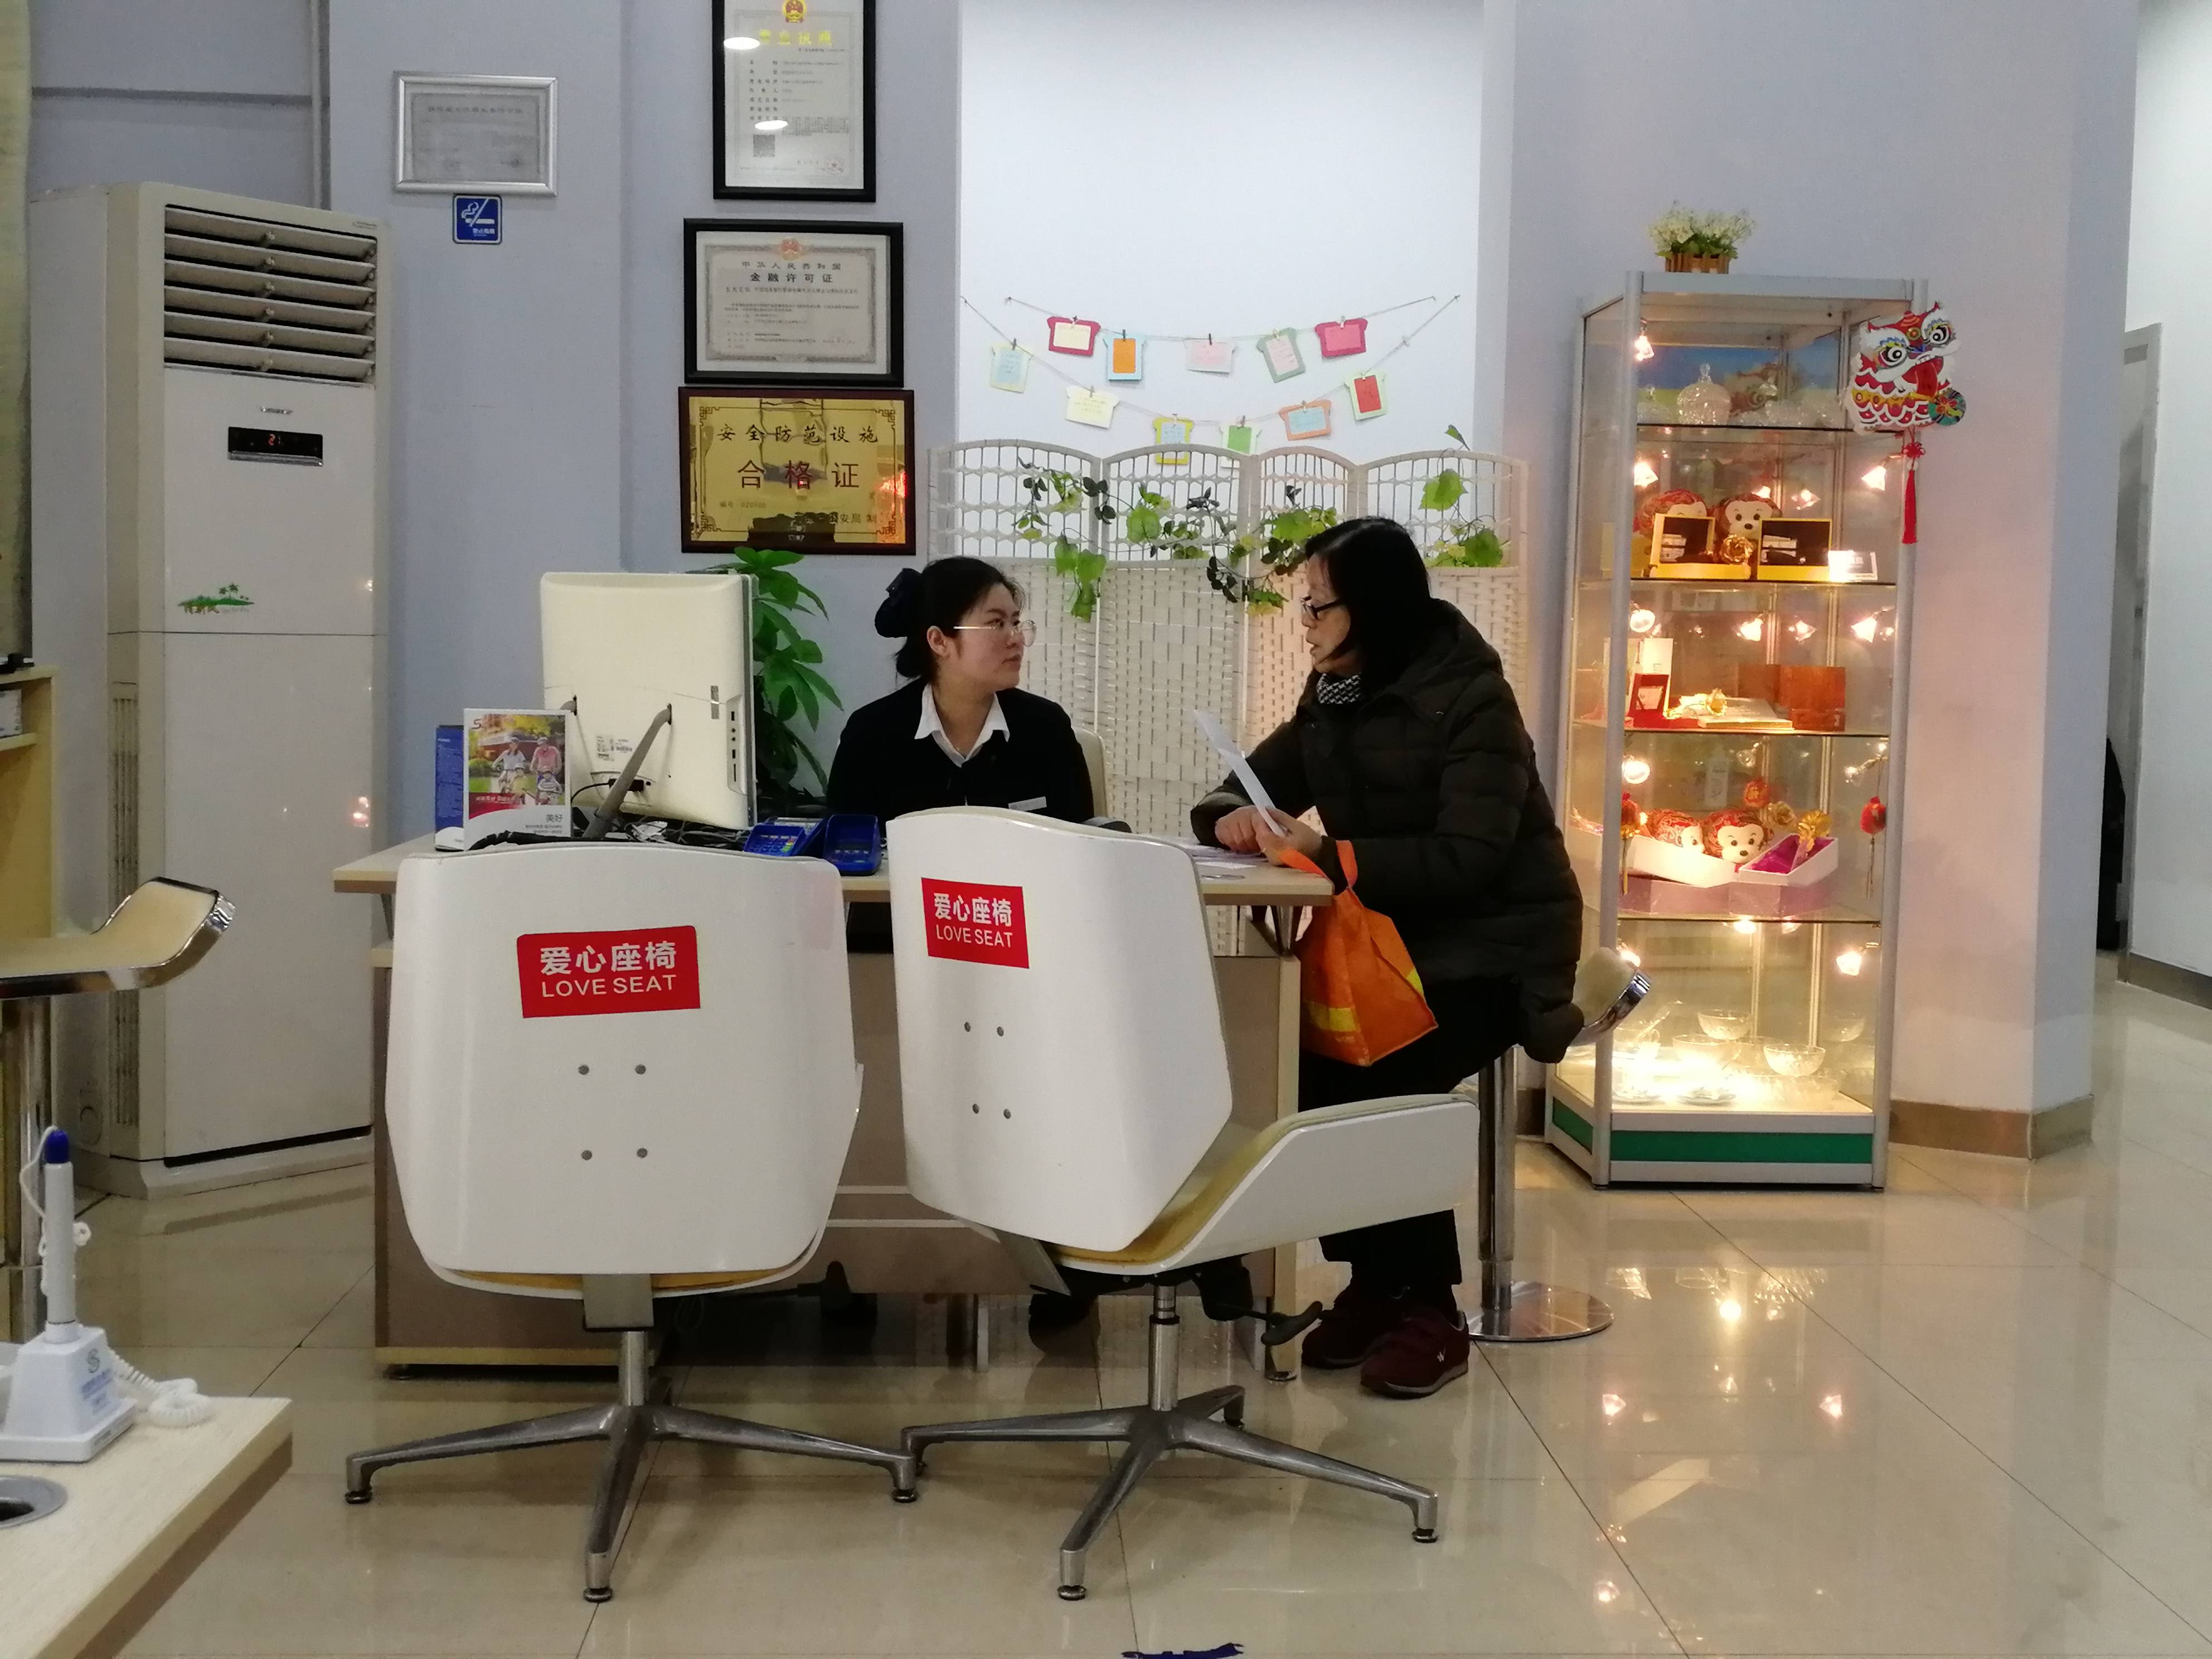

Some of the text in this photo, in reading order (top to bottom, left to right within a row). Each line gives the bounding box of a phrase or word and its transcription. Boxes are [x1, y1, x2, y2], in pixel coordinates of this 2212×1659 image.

[741, 261, 841, 270] 中华人民共和国
[750, 272, 833, 283] 金融许可证
[717, 424, 879, 444] 安全防范设施
[738, 459, 860, 489] 合格证
[934, 892, 1012, 927] 爱心座椅
[936, 924, 1013, 948] LOVE SEAT
[540, 940, 677, 976] 爱心座椅
[542, 974, 677, 998] LOVE SEAT
